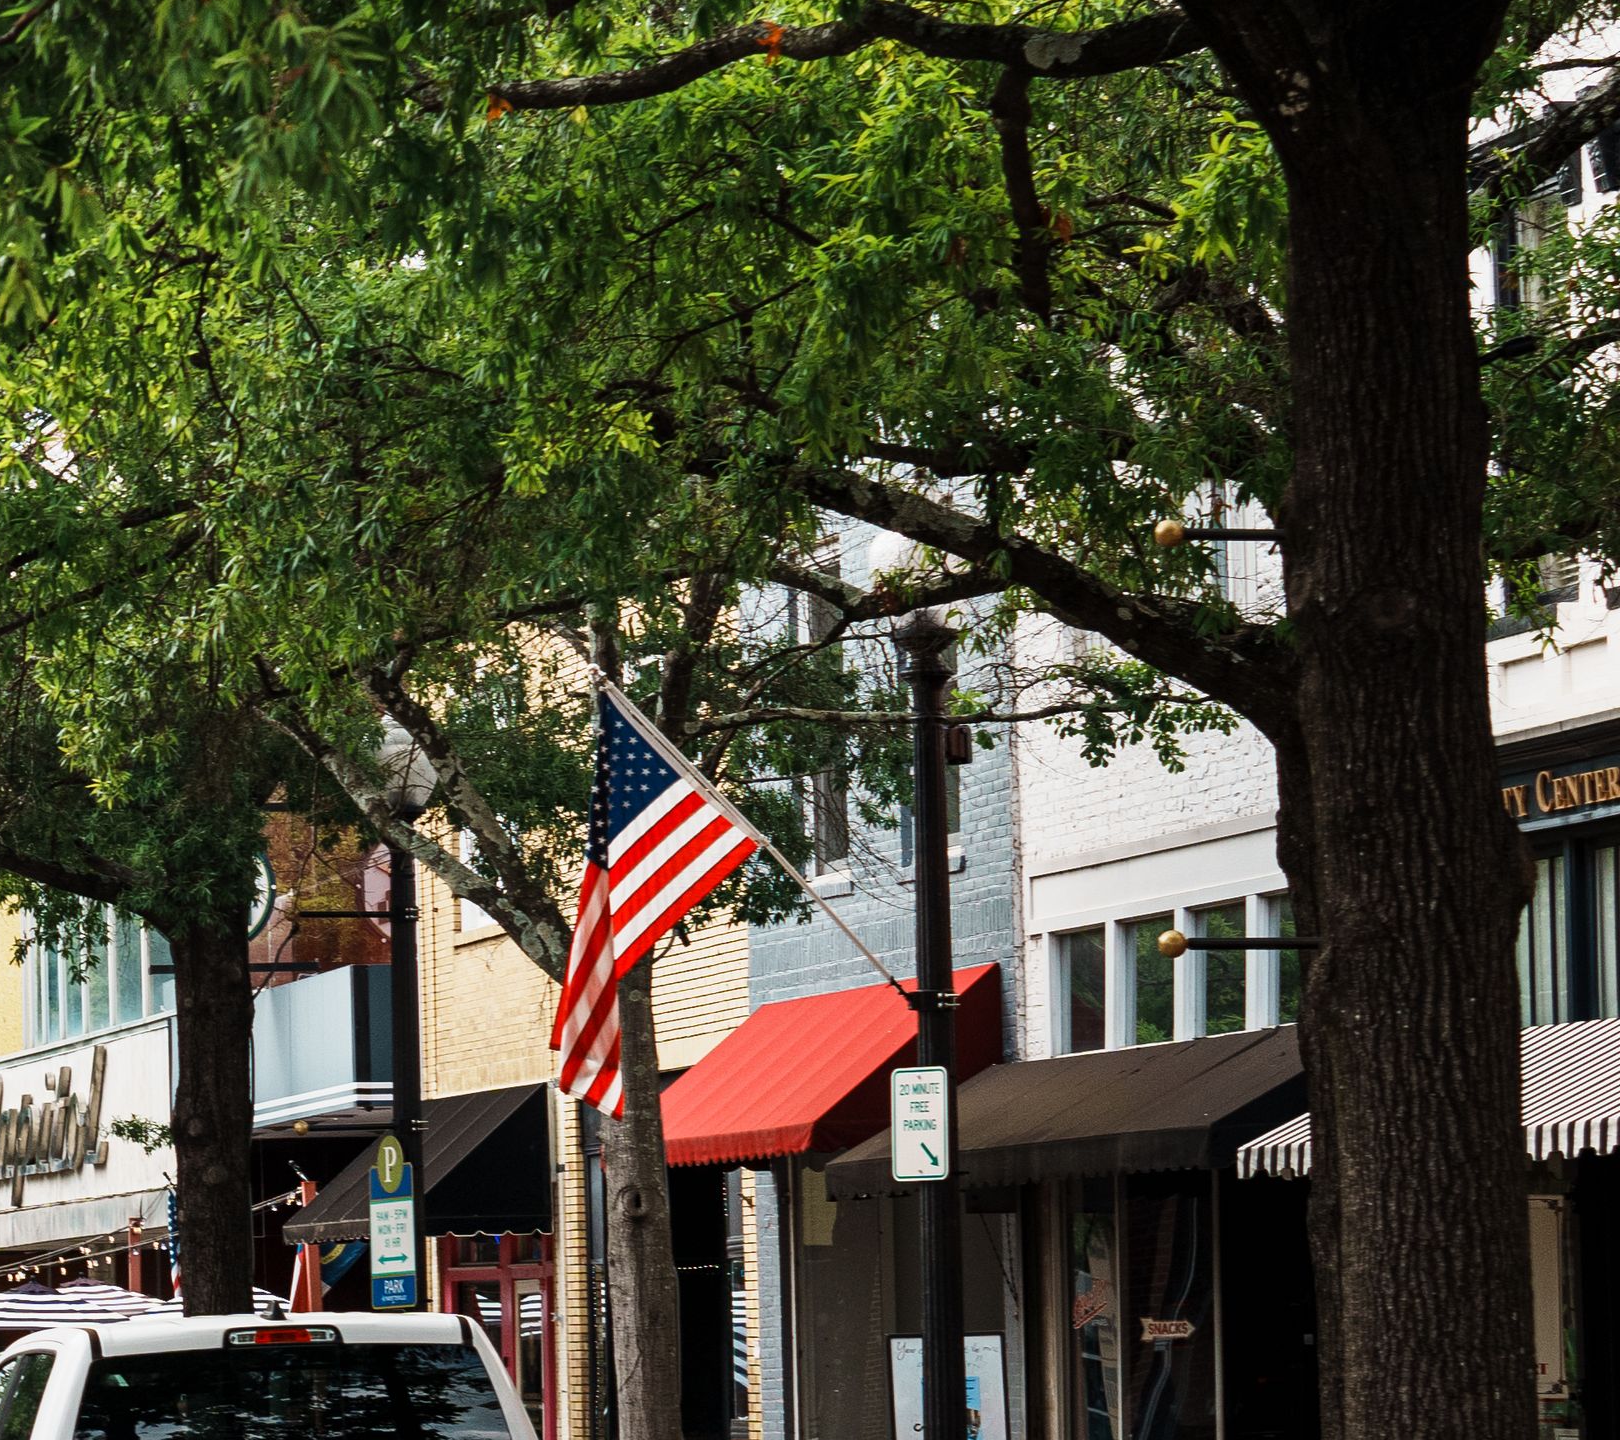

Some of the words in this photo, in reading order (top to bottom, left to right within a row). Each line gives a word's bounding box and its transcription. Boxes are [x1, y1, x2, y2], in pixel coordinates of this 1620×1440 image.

[1501, 784, 1528, 817] TY
[1535, 767, 1620, 813] CENTER
[900, 1084, 909, 1096] 20
[912, 1082, 940, 1095] MINUTE
[910, 1101, 930, 1113] FREE
[903, 1119, 937, 1131] PARKING
[383, 1146, 397, 1183] P
[384, 1279, 405, 1295] PARK
[1148, 1322, 1189, 1335] SNACKS
